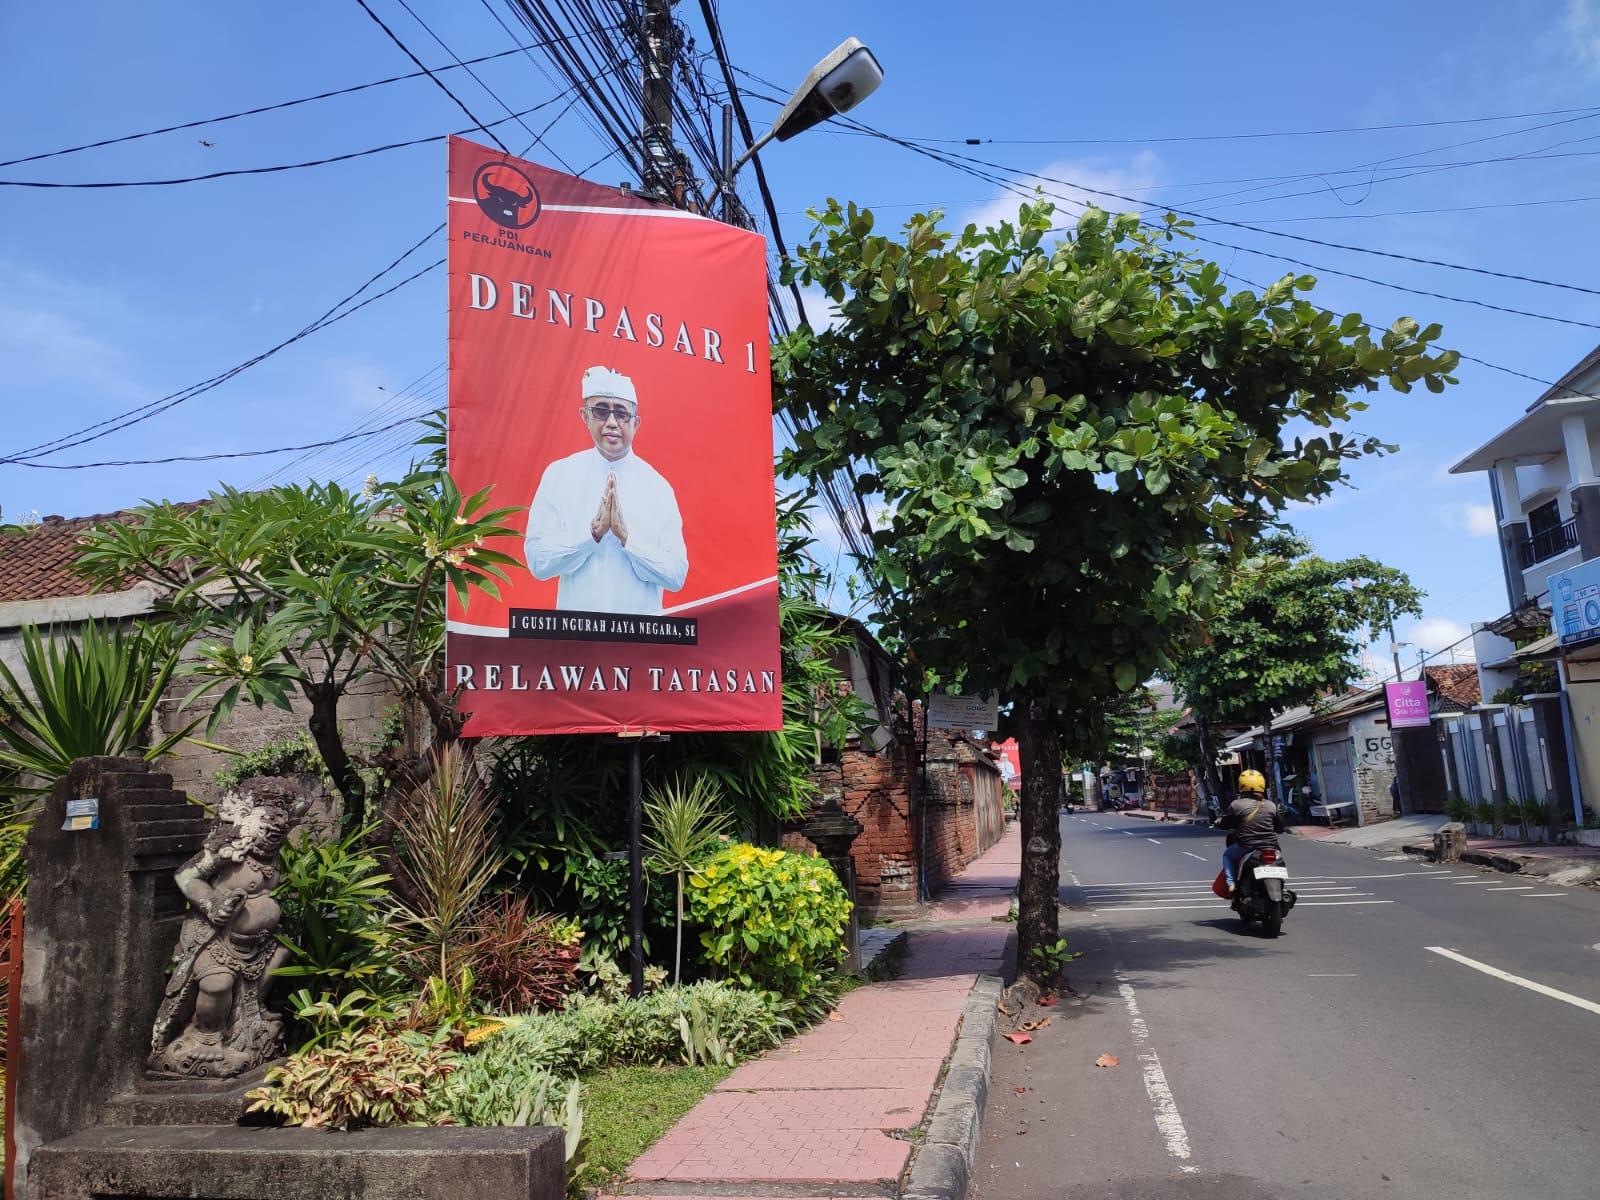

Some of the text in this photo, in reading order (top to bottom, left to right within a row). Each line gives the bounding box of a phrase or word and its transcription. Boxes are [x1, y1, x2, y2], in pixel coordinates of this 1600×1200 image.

[463, 231, 552, 259] PERJUANGAN
[499, 229, 519, 241] PDI
[468, 272, 758, 374] DENPASAR 1
[511, 615, 696, 639] I GUSTI NGURAH JAYA NEGARA, SE
[454, 664, 776, 693] RELAWAN TATASAN
